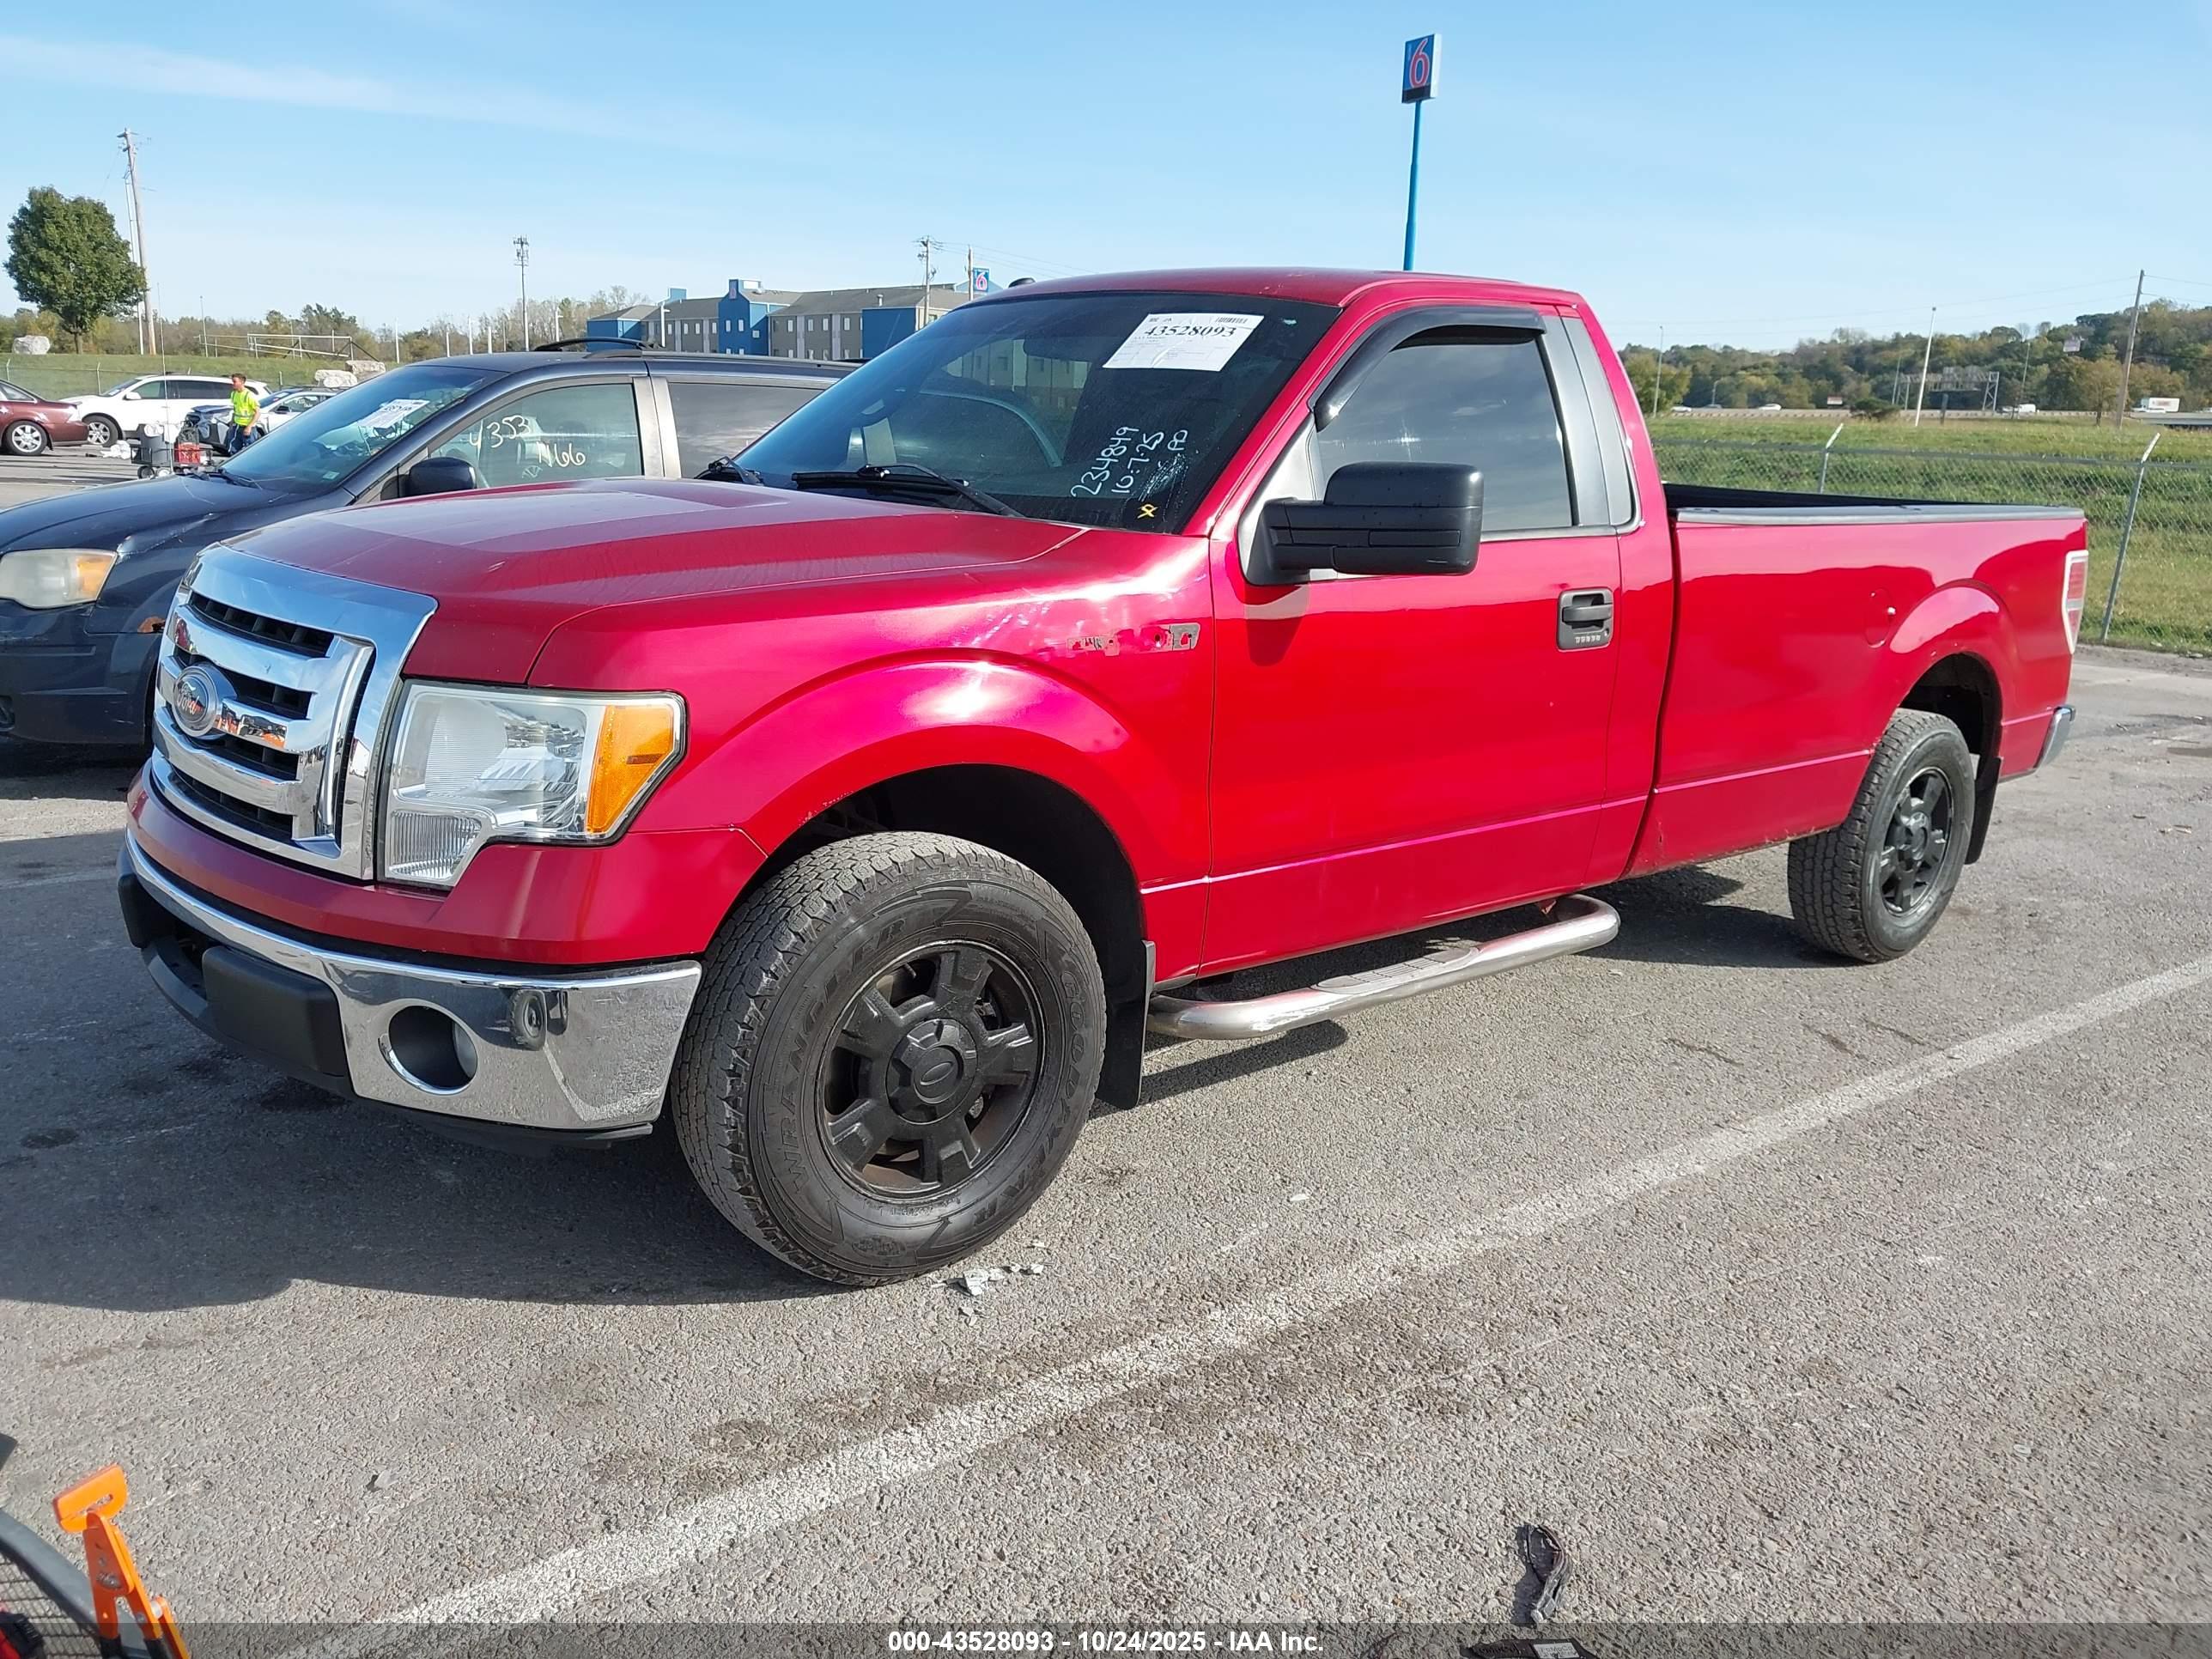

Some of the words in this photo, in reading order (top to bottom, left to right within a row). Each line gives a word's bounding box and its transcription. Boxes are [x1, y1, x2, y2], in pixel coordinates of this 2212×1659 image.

[1409, 38, 1430, 88] 6
[975, 271, 987, 290] 6
[1144, 325, 1237, 337] 43528093
[470, 415, 531, 460] 4353
